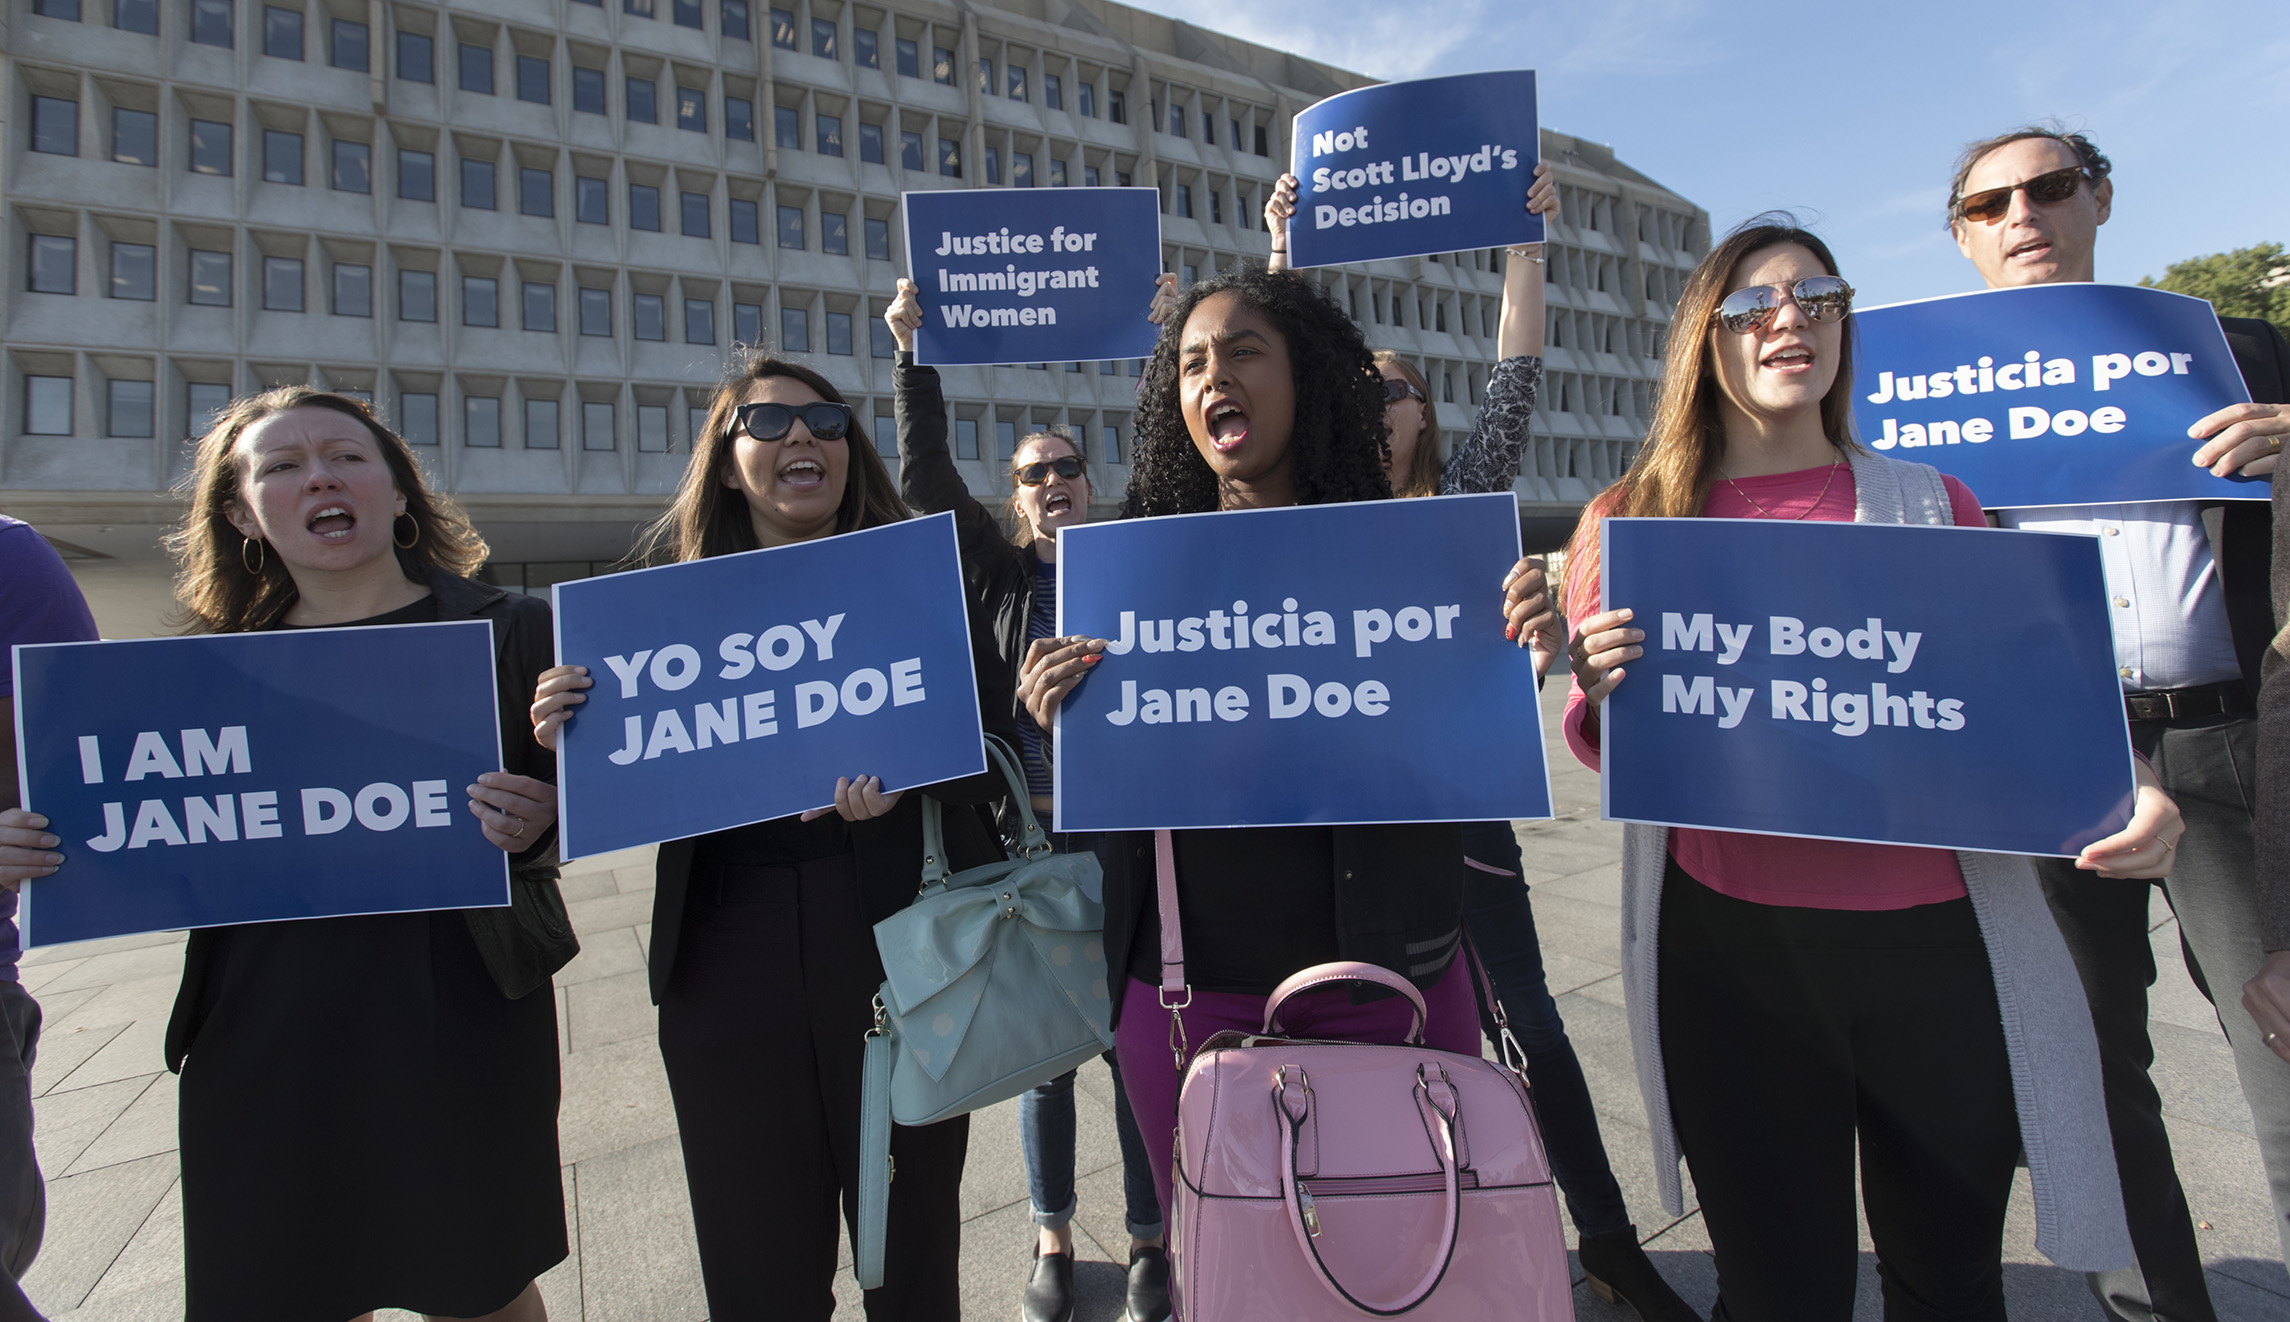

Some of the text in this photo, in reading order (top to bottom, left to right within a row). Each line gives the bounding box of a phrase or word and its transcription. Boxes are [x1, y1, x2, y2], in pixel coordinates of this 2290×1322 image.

[1313, 127, 1369, 157] Not
[1313, 144, 1518, 193] Scott Lloyd's
[1316, 192, 1451, 229] Decision
[935, 226, 1097, 256] Justice for
[939, 264, 1099, 297] Immigrant
[941, 305, 1056, 328] Women
[1867, 350, 2193, 404] Justicia por
[1872, 405, 2127, 451] Jane Doe
[1107, 597, 1460, 658] Justicia por
[1662, 612, 1923, 674] My Body
[602, 612, 846, 699] YO SOY
[607, 657, 926, 766] JANE DOE
[1106, 673, 1391, 726] Jane Doe
[1662, 674, 1966, 737] My Rights
[78, 725, 251, 784] I AM
[86, 779, 451, 852] JANE DOE
